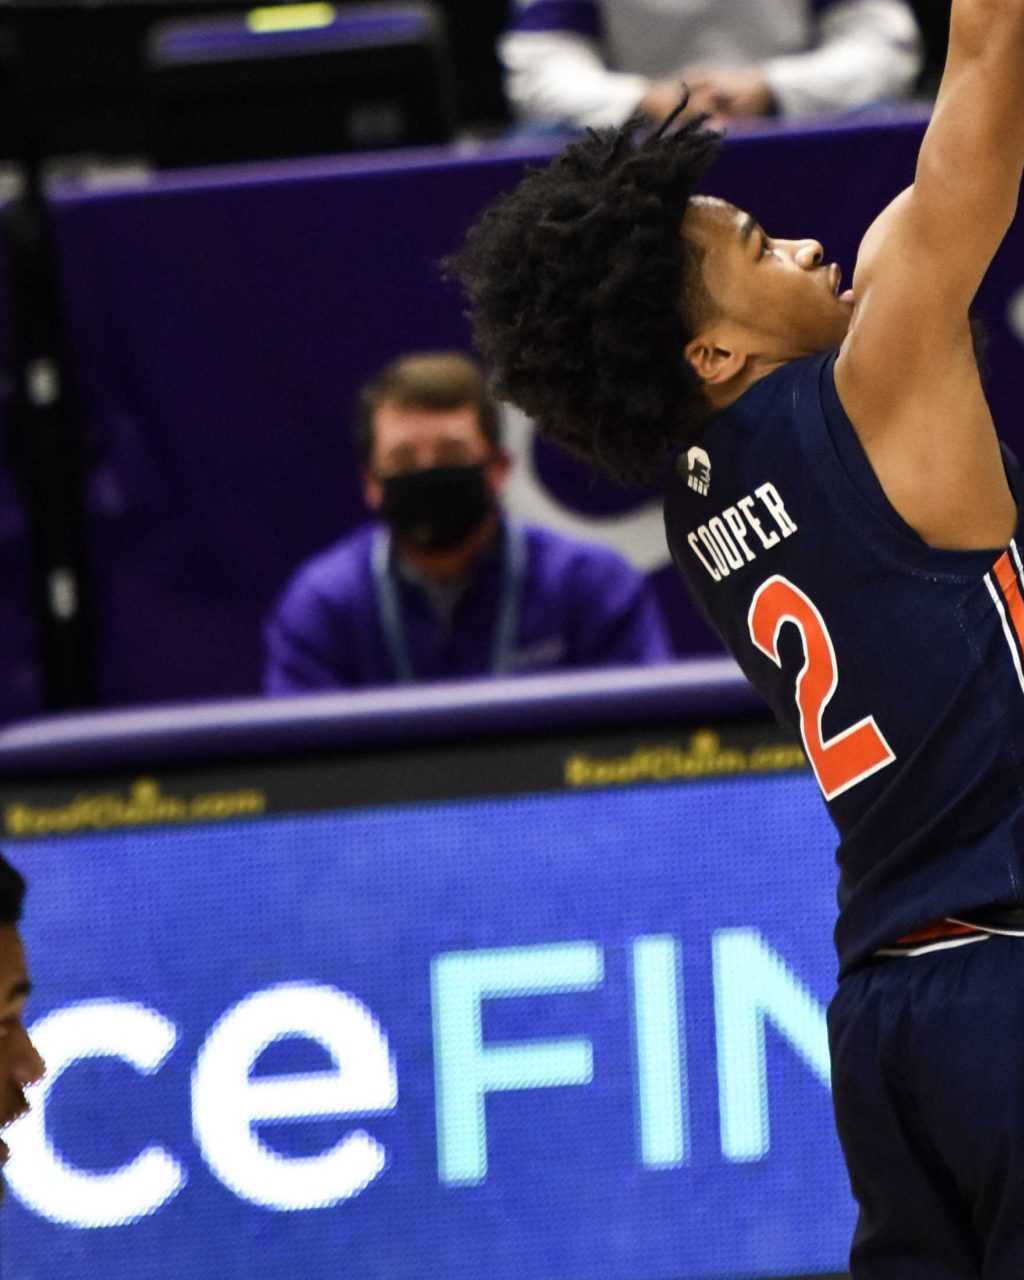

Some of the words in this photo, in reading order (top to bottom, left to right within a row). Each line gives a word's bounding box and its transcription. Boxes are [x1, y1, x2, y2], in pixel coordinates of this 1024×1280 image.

[687, 481, 798, 582] COOPER
[747, 573, 897, 802] 2
[564, 727, 806, 788] RoofClaim.co
